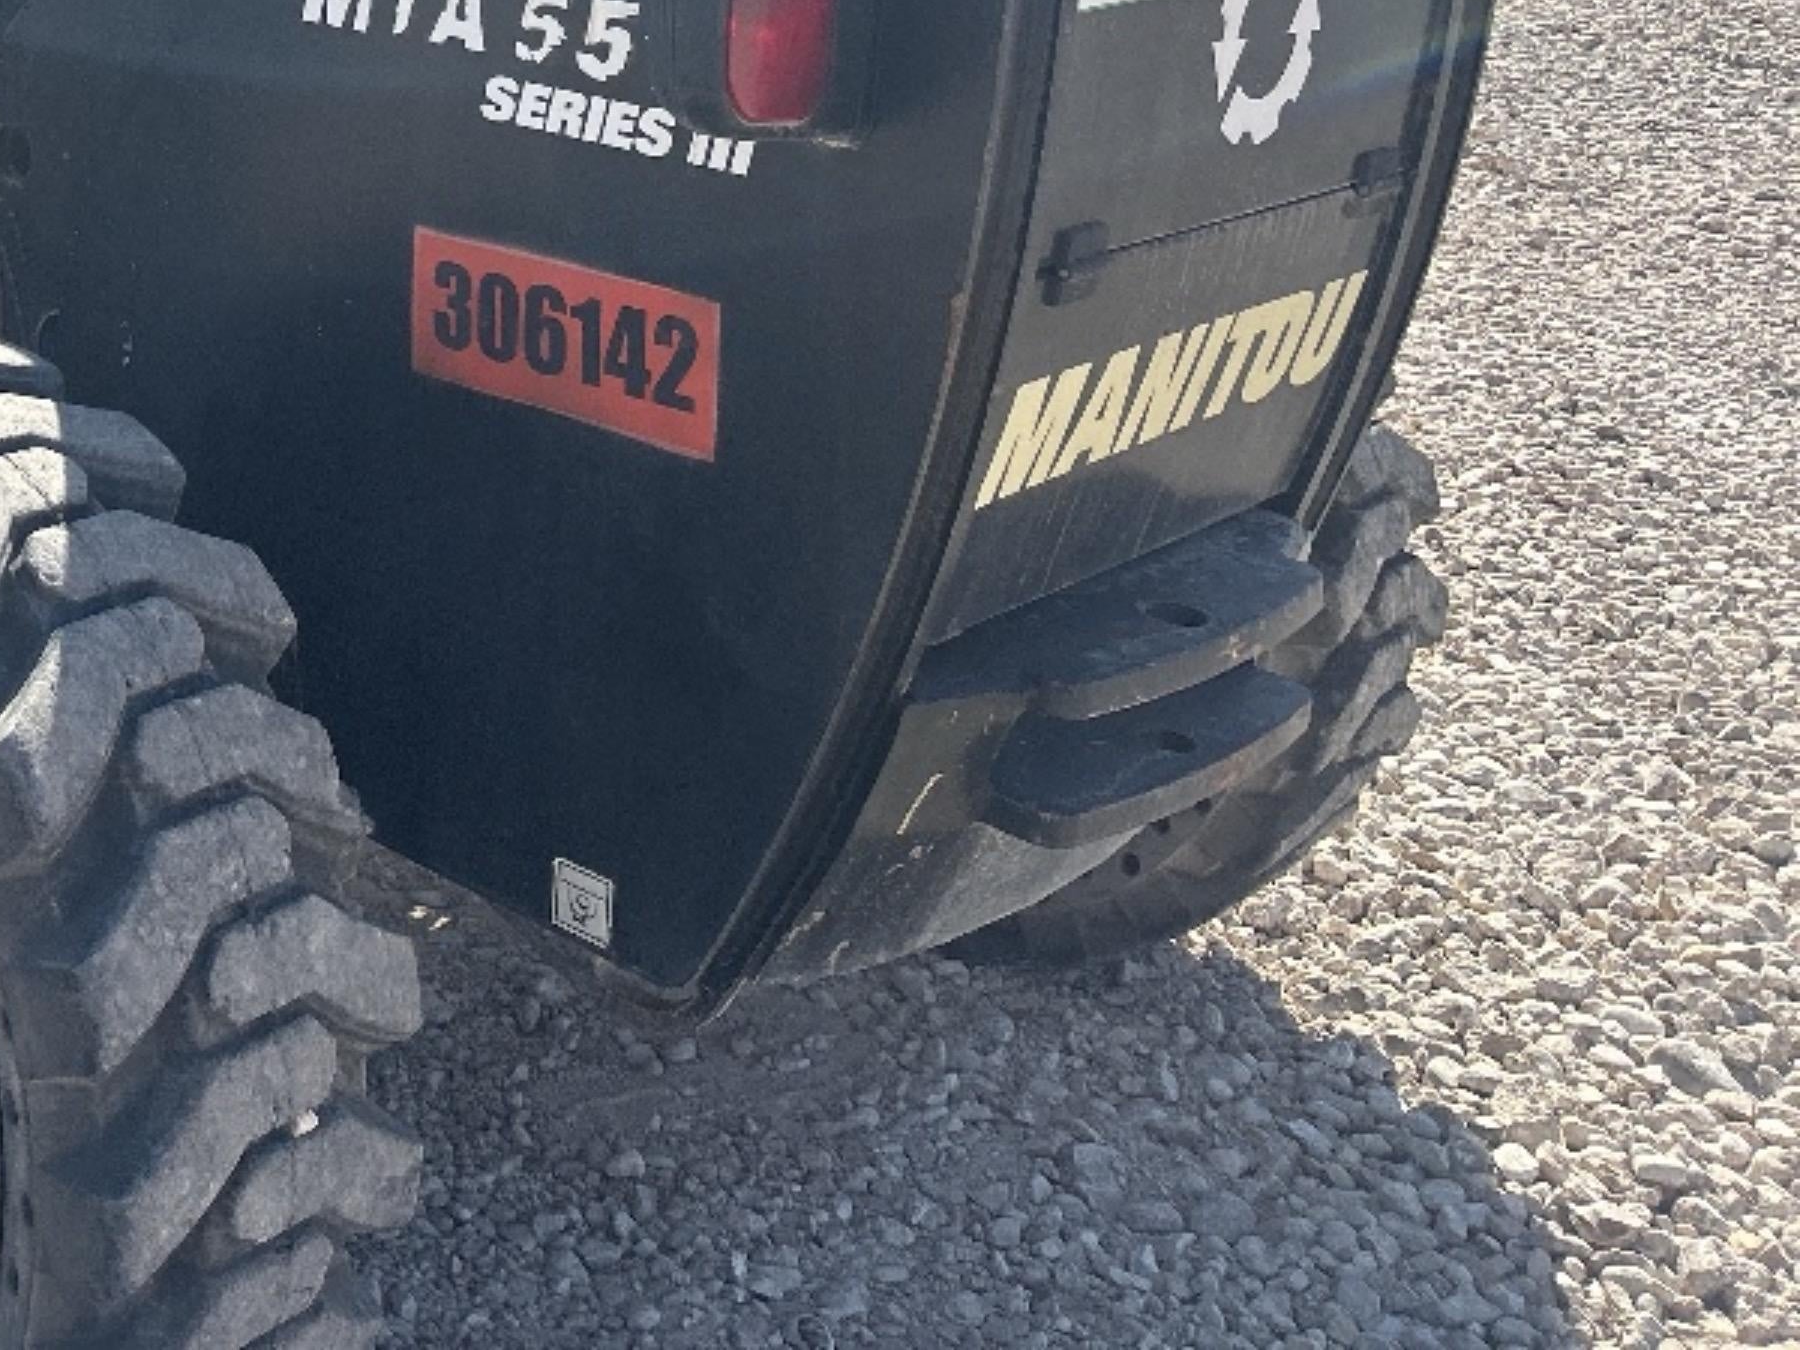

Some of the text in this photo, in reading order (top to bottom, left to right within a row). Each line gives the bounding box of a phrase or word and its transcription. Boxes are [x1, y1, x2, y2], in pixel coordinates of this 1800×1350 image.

[479, 75, 676, 158] SERIES
[432, 260, 699, 414] 306142
[974, 269, 1369, 511] MANITOU
